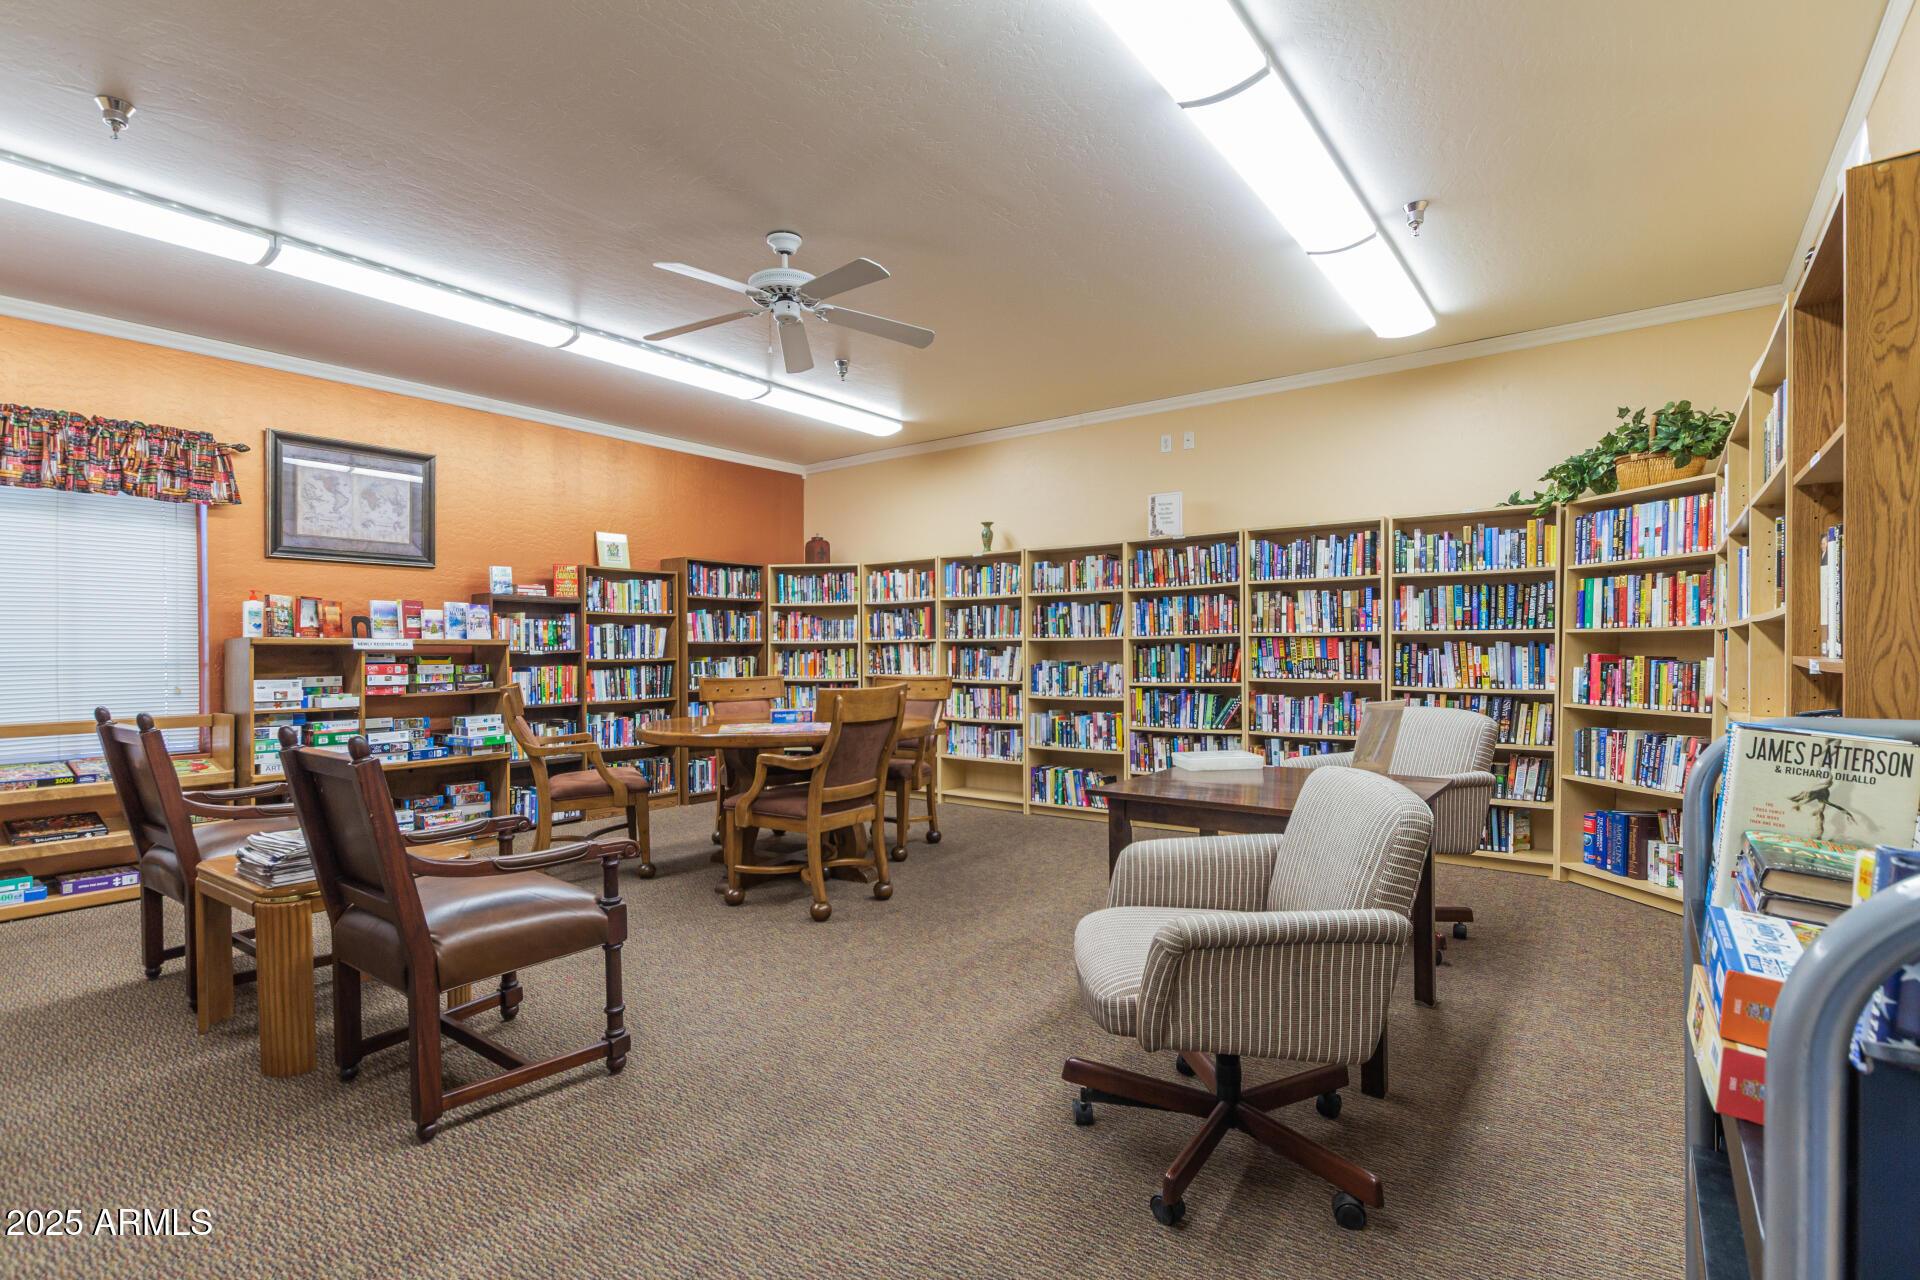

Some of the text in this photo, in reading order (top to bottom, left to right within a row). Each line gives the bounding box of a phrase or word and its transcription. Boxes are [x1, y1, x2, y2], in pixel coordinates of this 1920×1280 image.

[1746, 736, 1914, 778] JAMES PATTERSON
[1774, 765, 1876, 785] & RICHARD DILALLO
